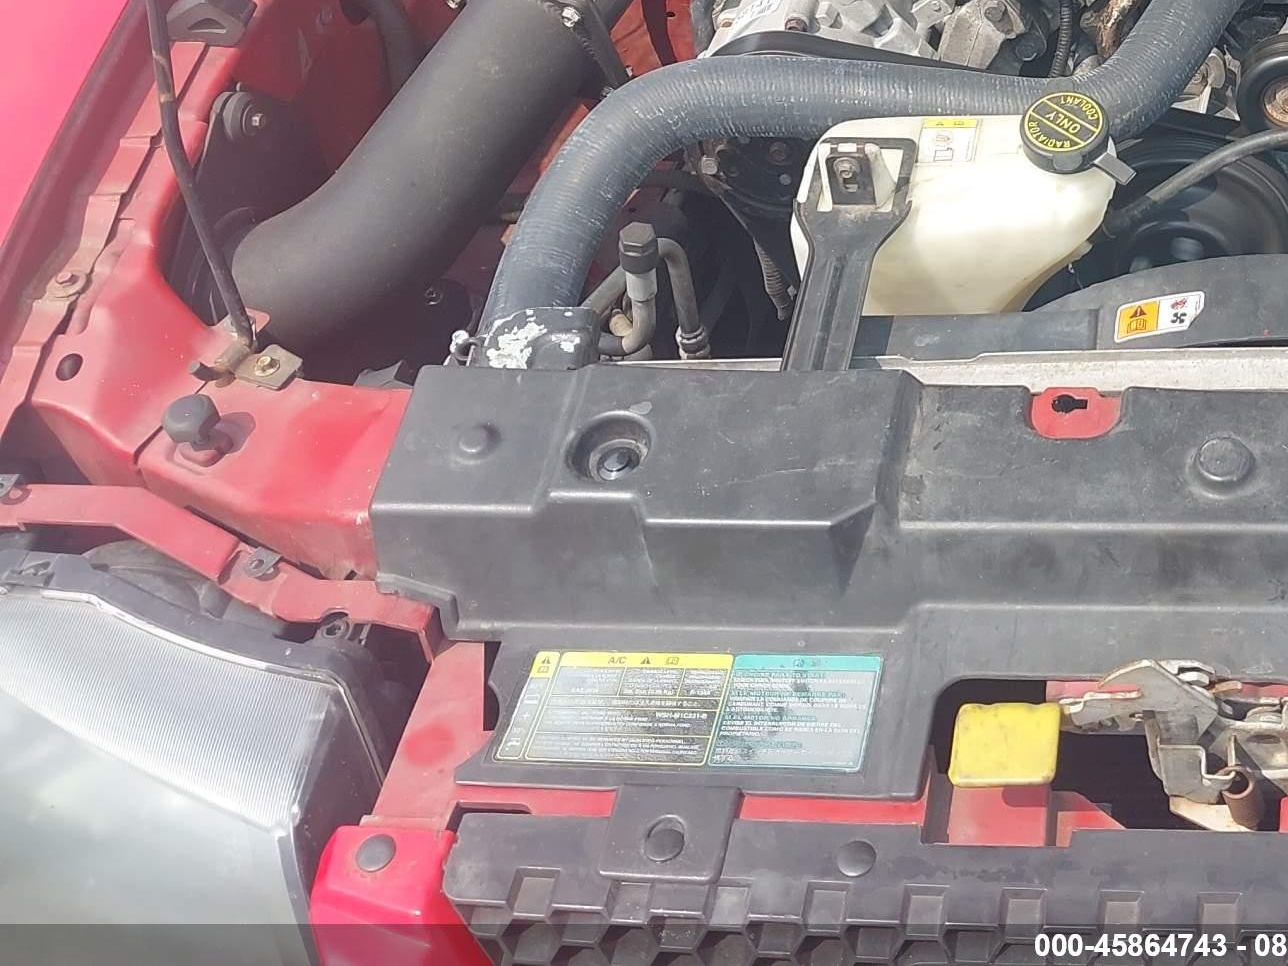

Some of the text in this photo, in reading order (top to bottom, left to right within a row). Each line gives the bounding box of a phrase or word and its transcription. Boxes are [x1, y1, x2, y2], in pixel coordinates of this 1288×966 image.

[1059, 95, 1099, 121] COOLANT
[1028, 120, 1071, 149] RADIATOR
[1046, 110, 1081, 135] ONLY
[607, 657, 627, 665] A/C
